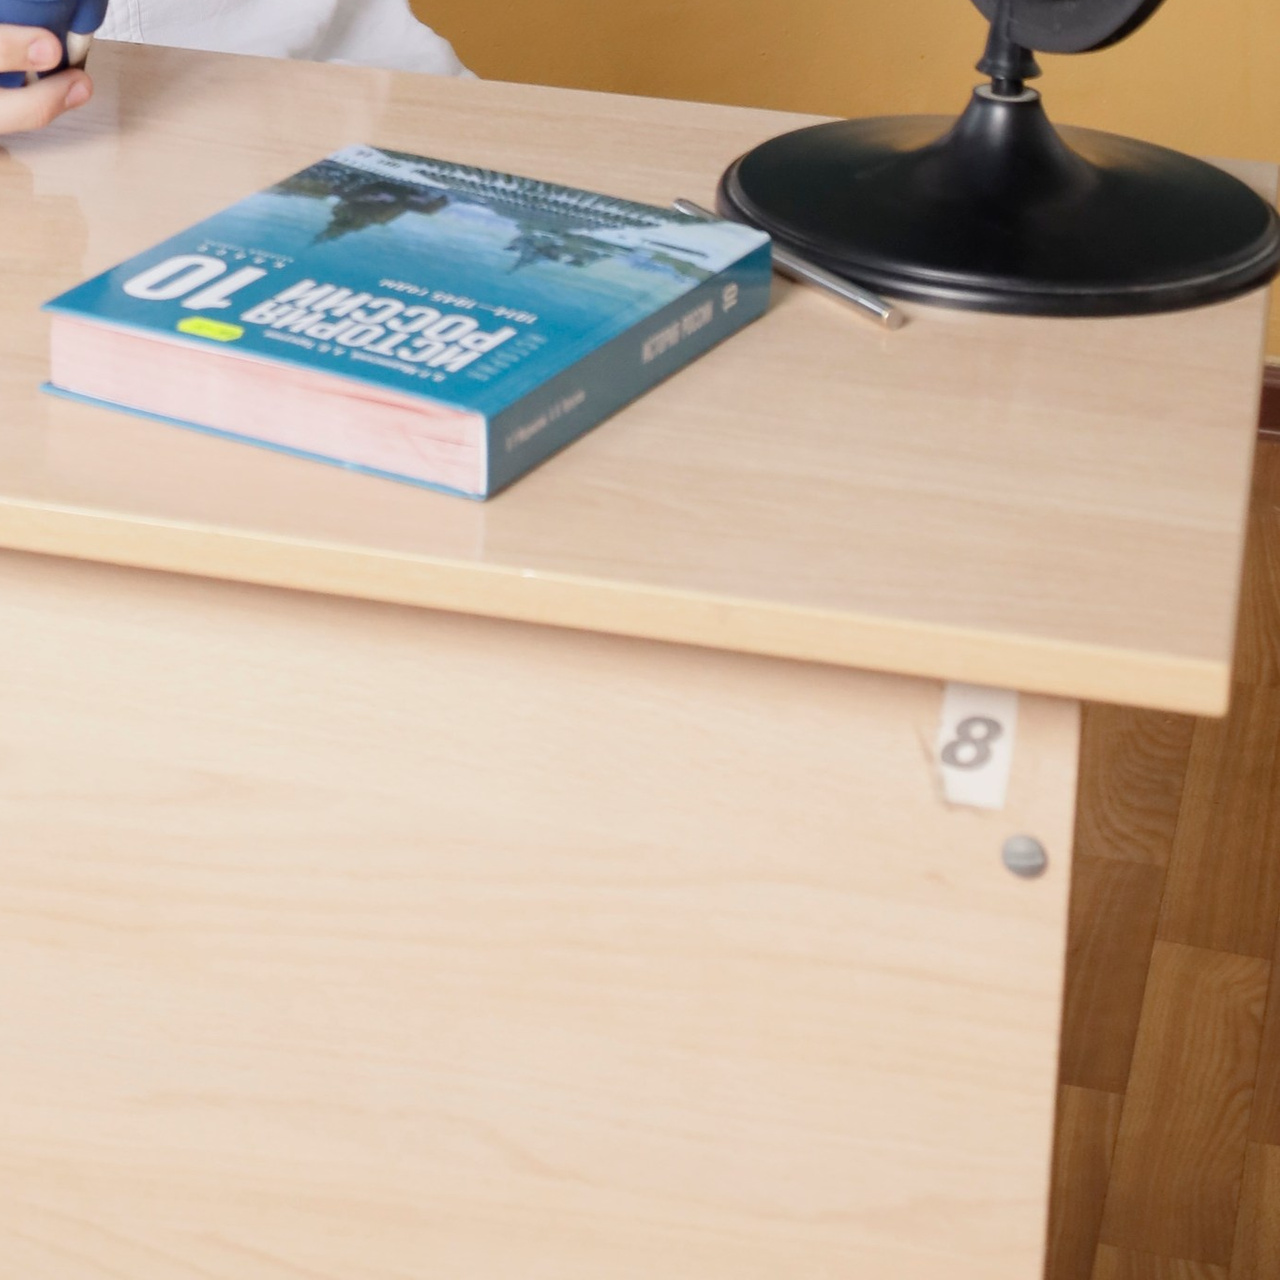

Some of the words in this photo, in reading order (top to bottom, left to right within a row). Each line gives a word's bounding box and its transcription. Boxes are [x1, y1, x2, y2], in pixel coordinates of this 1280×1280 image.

[121, 252, 269, 312] 10
[239, 299, 483, 374] ИСТОРИЯ
[272, 278, 517, 354] РОССИИ
[940, 715, 1005, 772] 8
